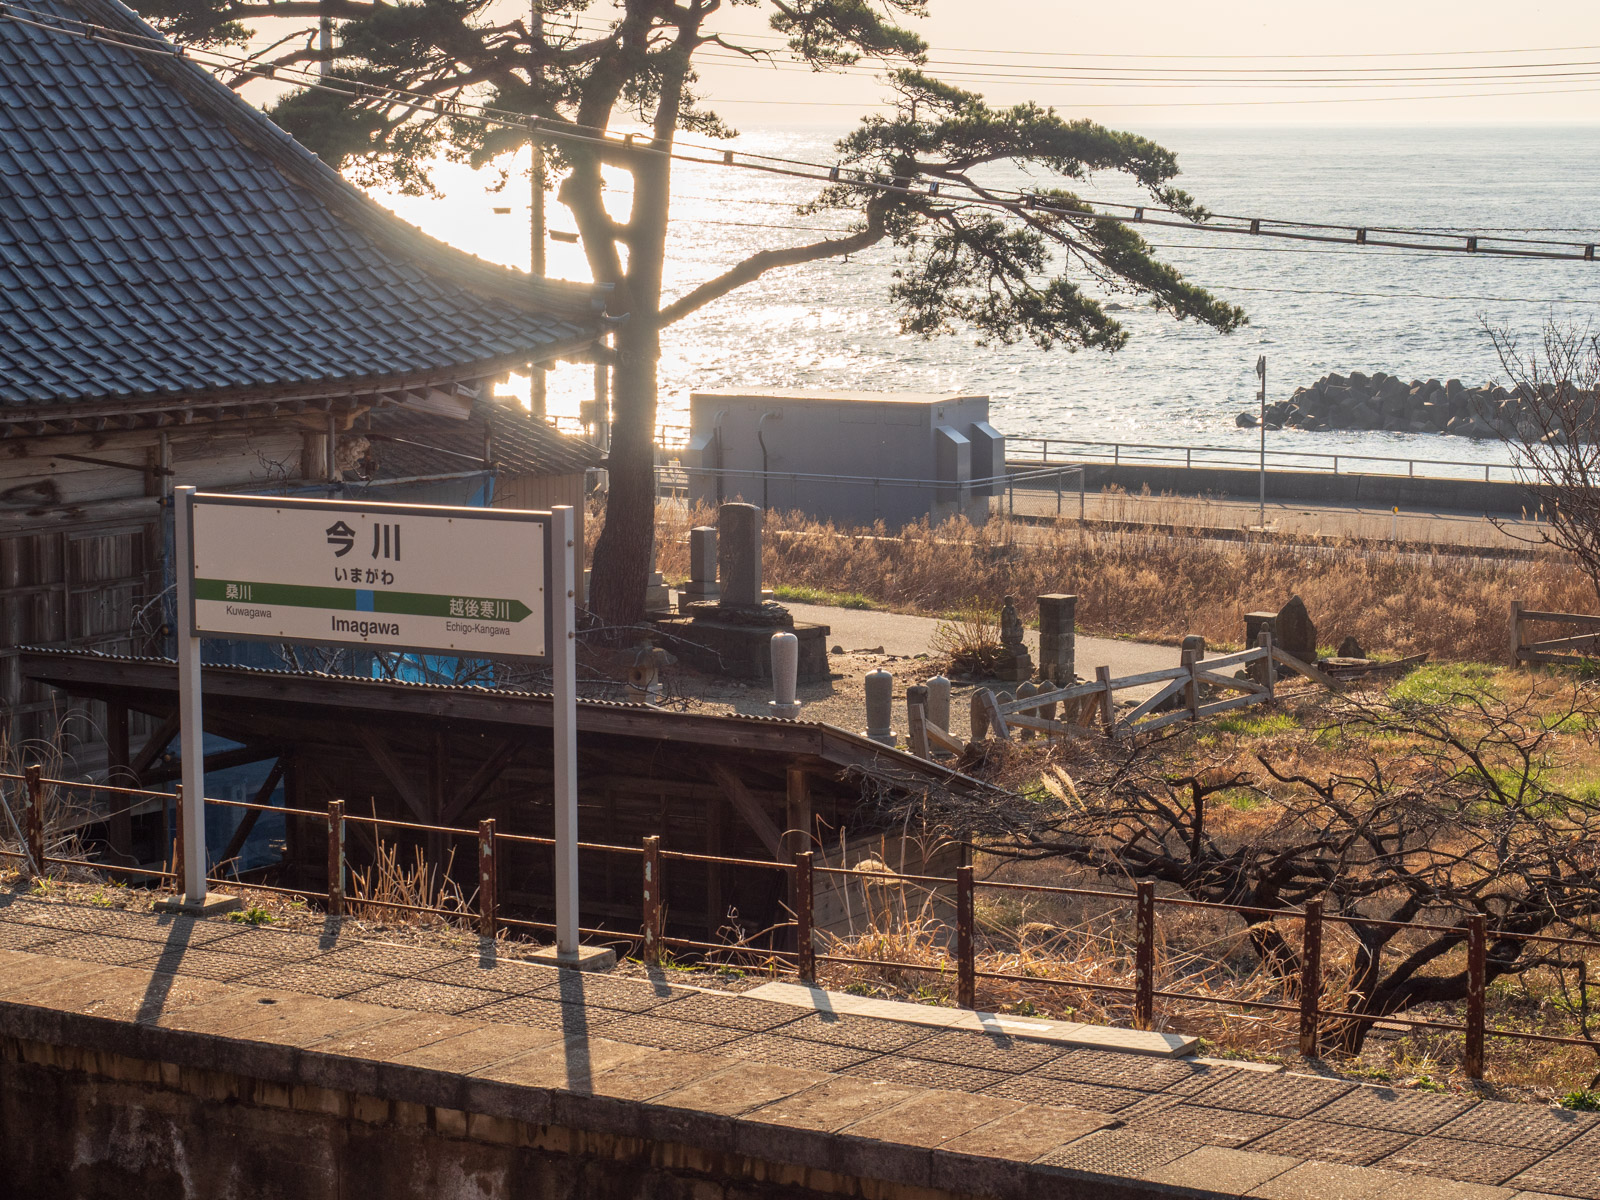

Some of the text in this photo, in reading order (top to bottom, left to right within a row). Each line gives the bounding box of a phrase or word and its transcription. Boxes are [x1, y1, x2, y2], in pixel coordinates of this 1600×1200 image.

[325, 520, 401, 561] 今川
[334, 566, 395, 586] いまがわ
[225, 583, 252, 601] 桑川
[226, 605, 272, 619] Kuwagawa
[449, 597, 511, 621] 越後寒川
[331, 616, 400, 638] Imagawa
[446, 621, 511, 637] Echigo-Kangawa
